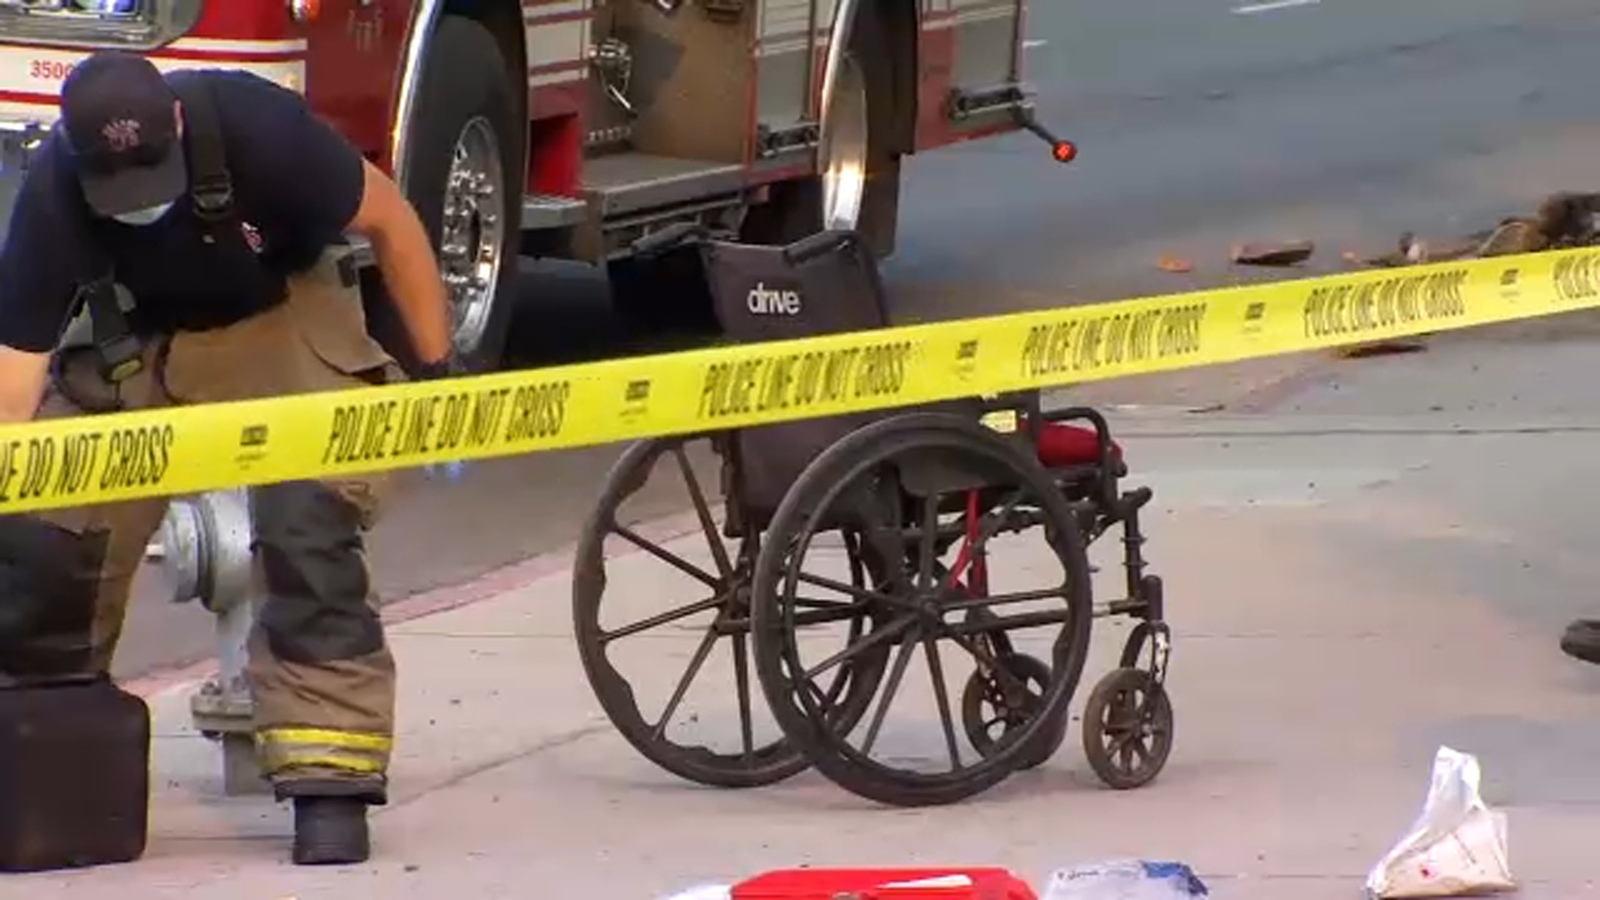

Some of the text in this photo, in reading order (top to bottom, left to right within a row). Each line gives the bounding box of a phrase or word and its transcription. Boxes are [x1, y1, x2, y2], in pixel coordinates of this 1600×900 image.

[747, 282, 800, 315] drive
[1303, 284, 1352, 338] POLICE
[1021, 302, 1206, 377] POLICE LINE DO NOT CROSS
[697, 358, 763, 418] POLICE
[757, 355, 799, 411] LINE
[794, 350, 824, 406] DO
[819, 346, 860, 403] NOT
[854, 340, 911, 398] CROSS
[320, 380, 570, 465] POLICE LINE DO NOT CROSS
[18, 436, 55, 499] DO
[51, 431, 103, 497] NOT
[99, 423, 174, 490] CROSS
